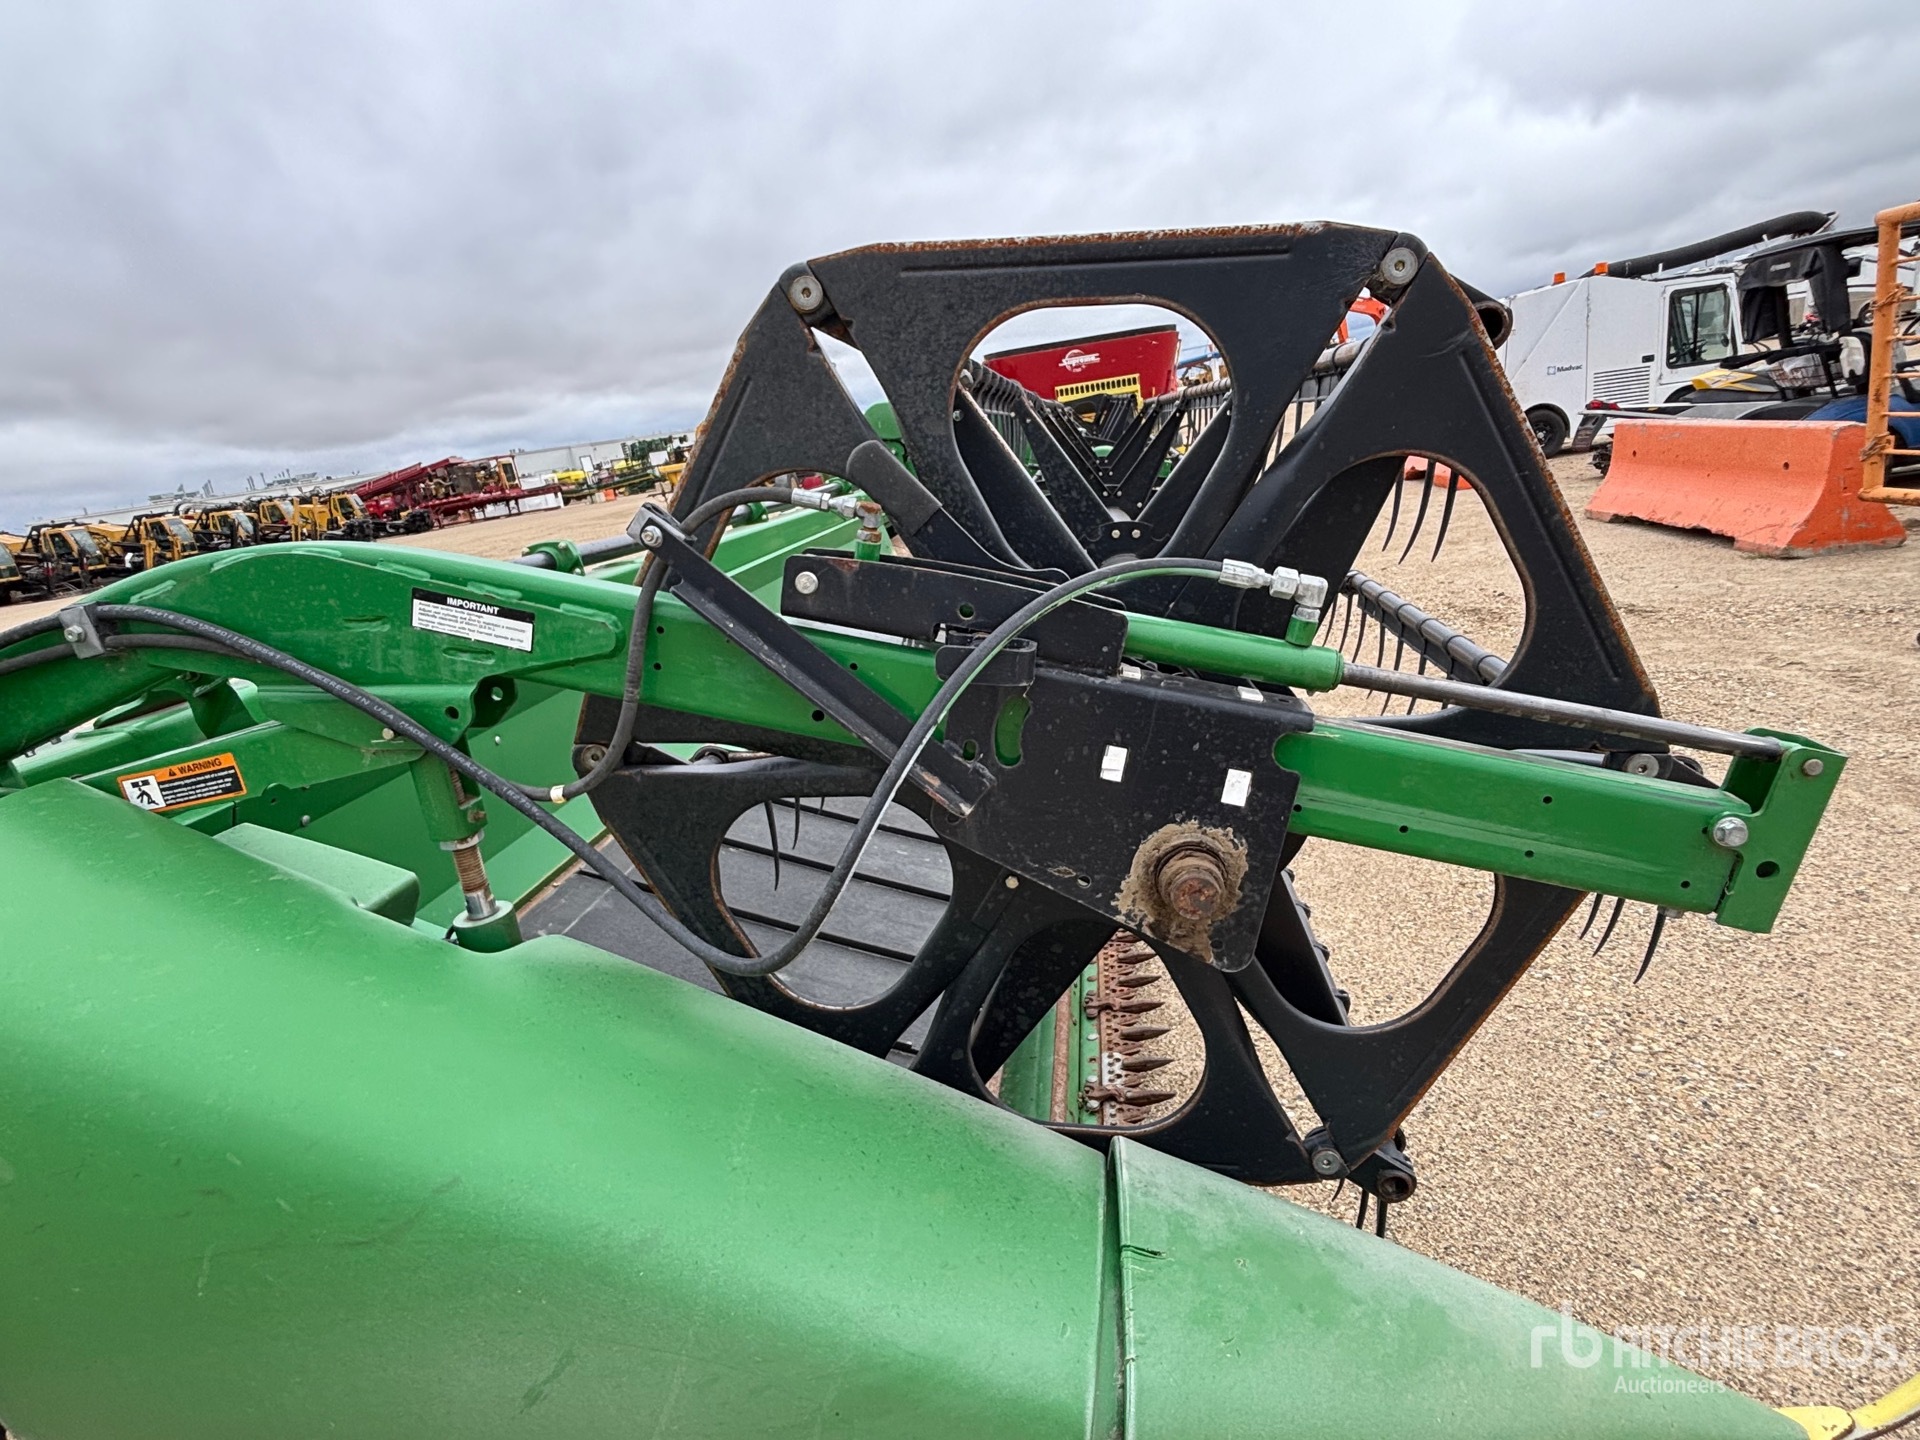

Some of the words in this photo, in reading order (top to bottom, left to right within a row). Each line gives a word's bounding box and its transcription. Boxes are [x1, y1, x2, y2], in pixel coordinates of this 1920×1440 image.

[446, 596, 500, 615] IMPORTANT
[285, 659, 352, 694] ENGINEERED
[356, 695, 371, 706] IN
[374, 705, 394, 720] USA
[400, 721, 428, 740] MADE
[433, 741, 448, 752] IN
[451, 753, 489, 778] BRAZIL
[177, 758, 222, 775] WARNING
